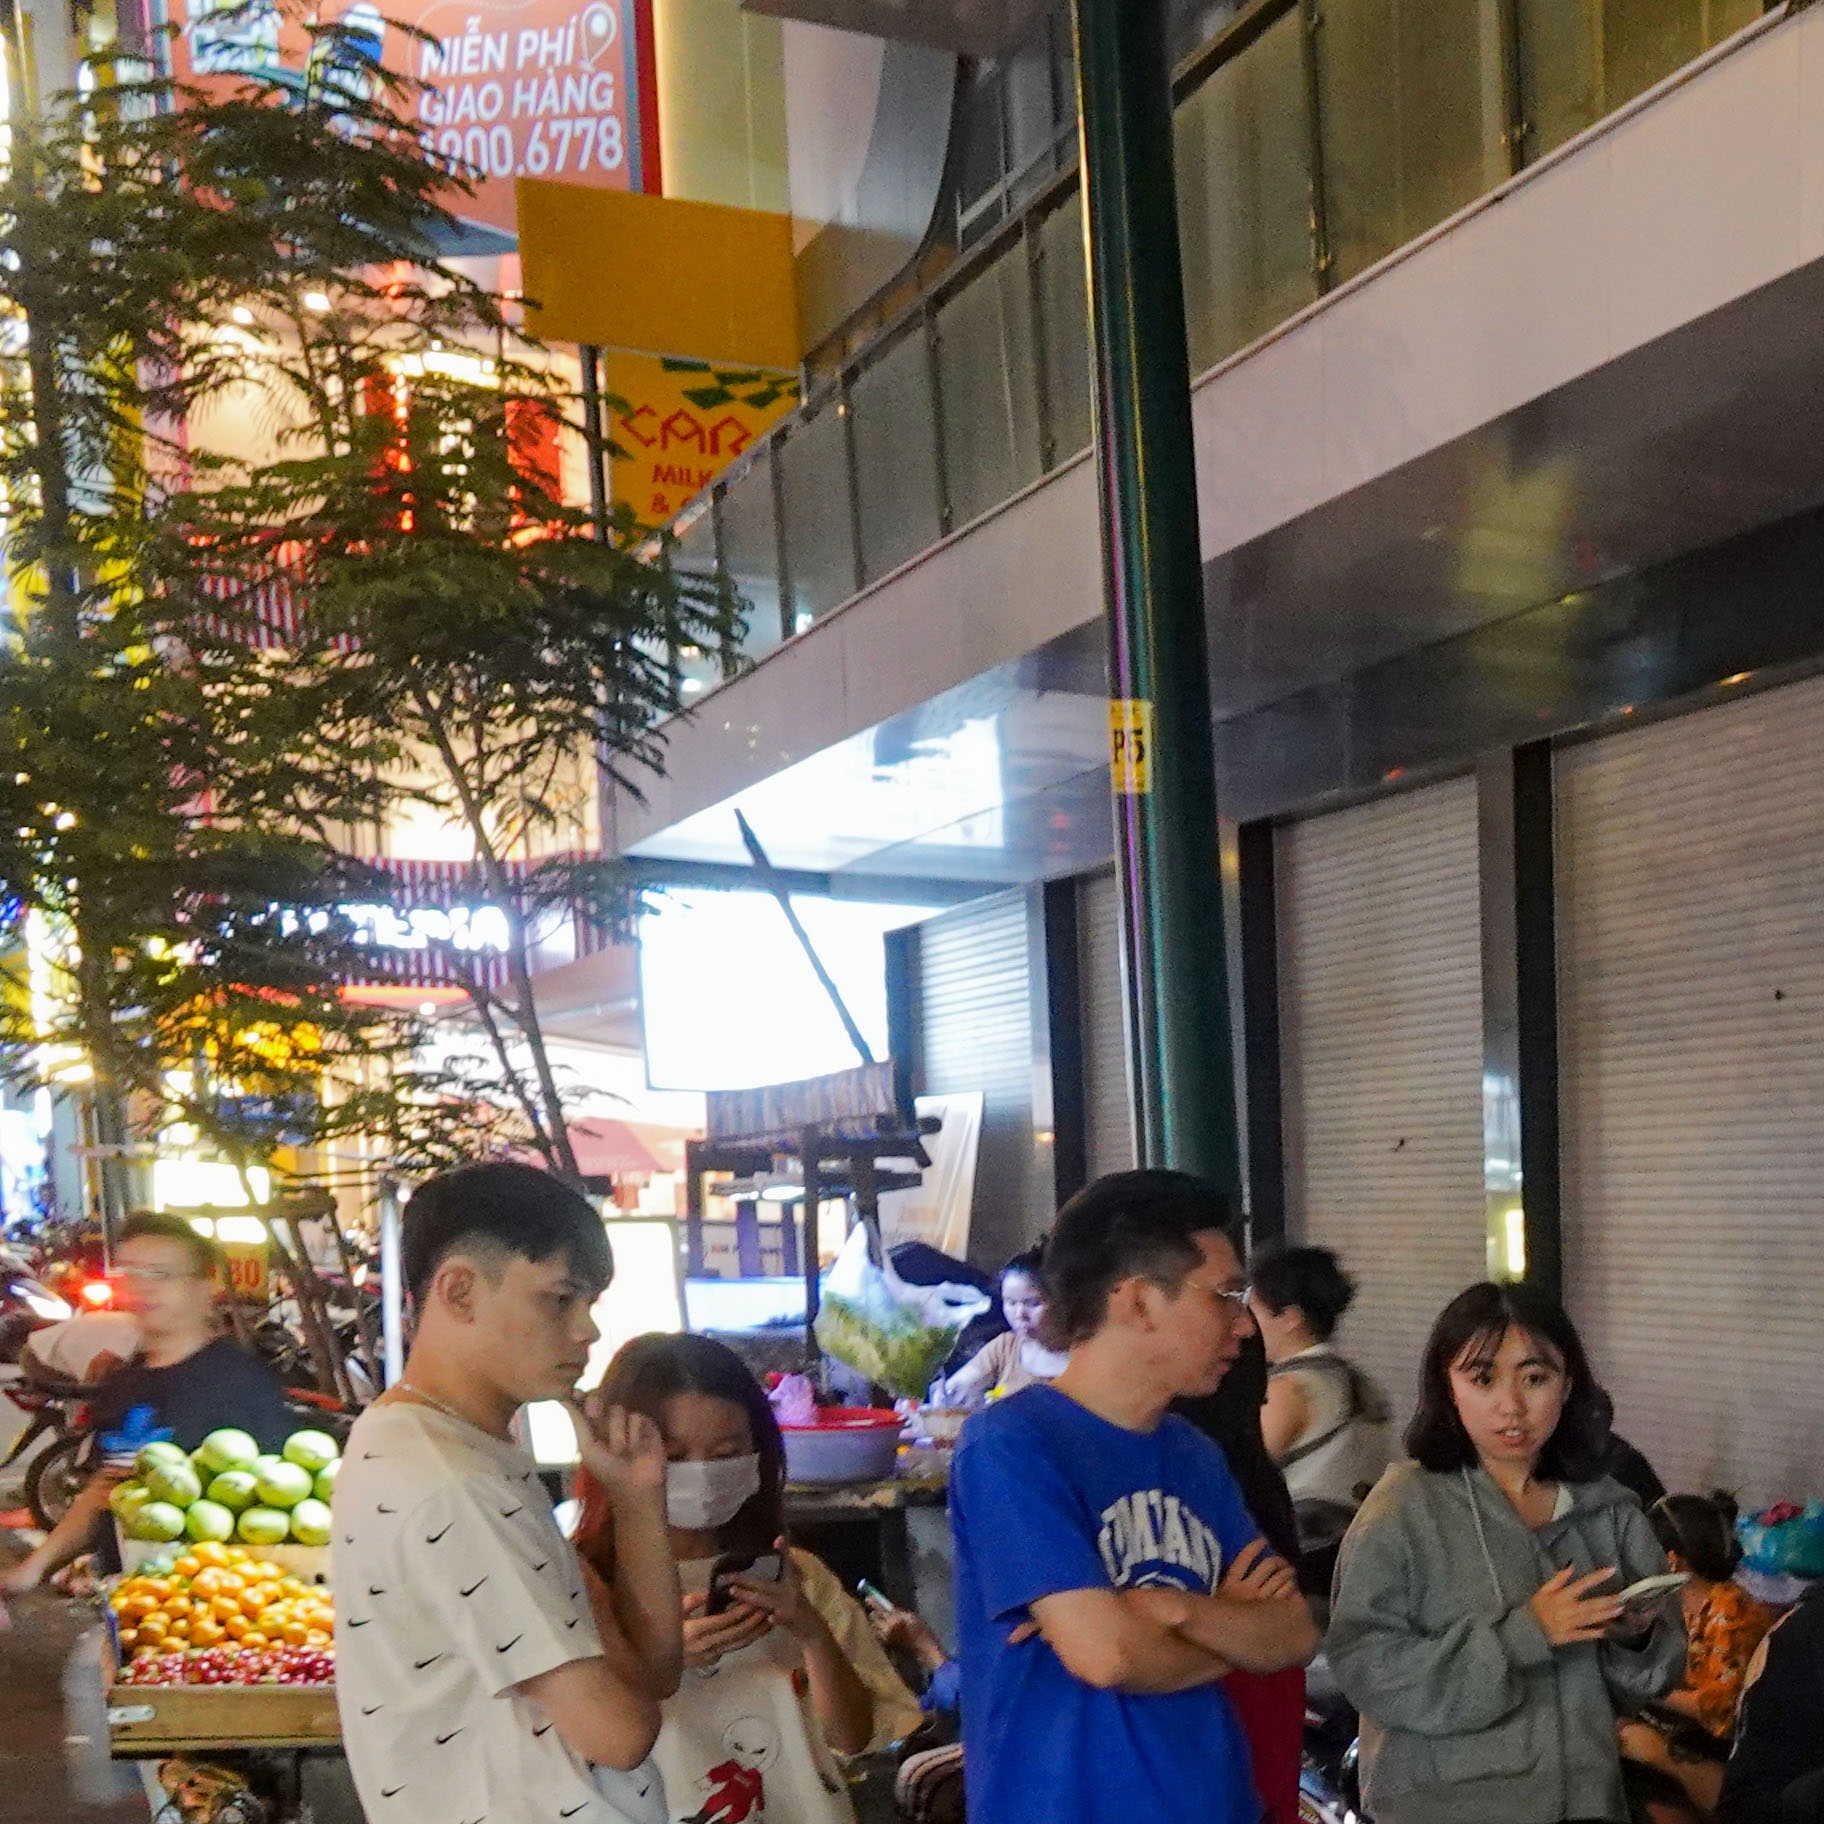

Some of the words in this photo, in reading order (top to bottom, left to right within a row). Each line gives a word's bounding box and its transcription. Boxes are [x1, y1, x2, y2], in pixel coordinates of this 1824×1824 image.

[420, 15, 508, 80] MIỄN
[516, 14, 578, 70] PHÍ
[419, 80, 504, 125] GIAO
[511, 66, 614, 118] HÀNG
